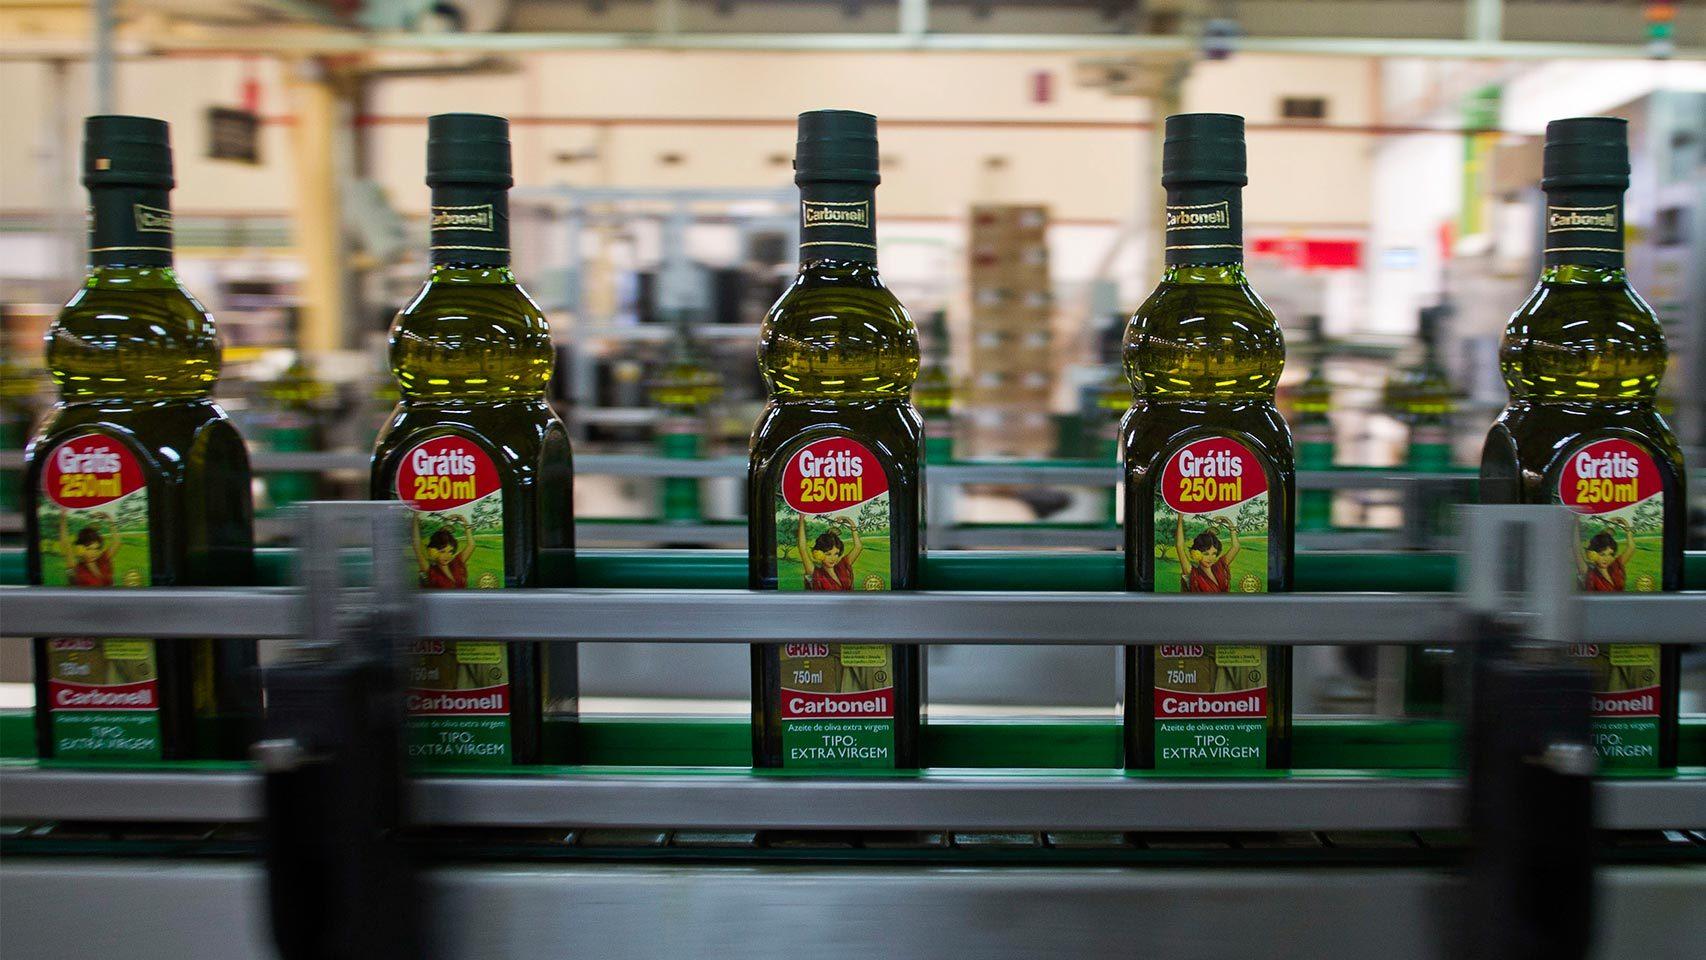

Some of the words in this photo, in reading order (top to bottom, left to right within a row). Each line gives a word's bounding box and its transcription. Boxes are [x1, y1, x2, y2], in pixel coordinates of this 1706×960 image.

[806, 207, 865, 222] Carbonell
[1550, 212, 1614, 226] Carbonell
[57, 447, 122, 473] Grátis
[412, 448, 476, 475] Grátis
[799, 450, 863, 477] Grátis
[1178, 450, 1243, 477] Grátis
[1575, 451, 1639, 478] Grátis
[56, 688, 152, 706] Carbonell
[407, 694, 503, 711] Carbonell
[789, 696, 887, 714] Carbonell
[1162, 696, 1260, 714] Carbonell
[1591, 695, 1654, 712] bonell
[787, 723, 812, 732] Azeite
[813, 723, 823, 732] de
[824, 723, 841, 731] oliva
[864, 723, 890, 733] virgem
[1160, 723, 1184, 732] Azeite
[1185, 723, 1196, 732] de
[1196, 723, 1214, 731] oliva
[1237, 723, 1262, 733] virgem
[439, 731, 474, 743] TIPO:
[821, 734, 857, 746] TIPO:
[1194, 734, 1229, 746] TIPO:
[408, 743, 453, 756] EXTRA
[454, 743, 505, 755] VIRGEM
[791, 747, 836, 760] EXTRA
[838, 746, 888, 759] VIRGEM
[1162, 747, 1207, 760] EXTRA
[1209, 746, 1260, 759] VIRGEM
